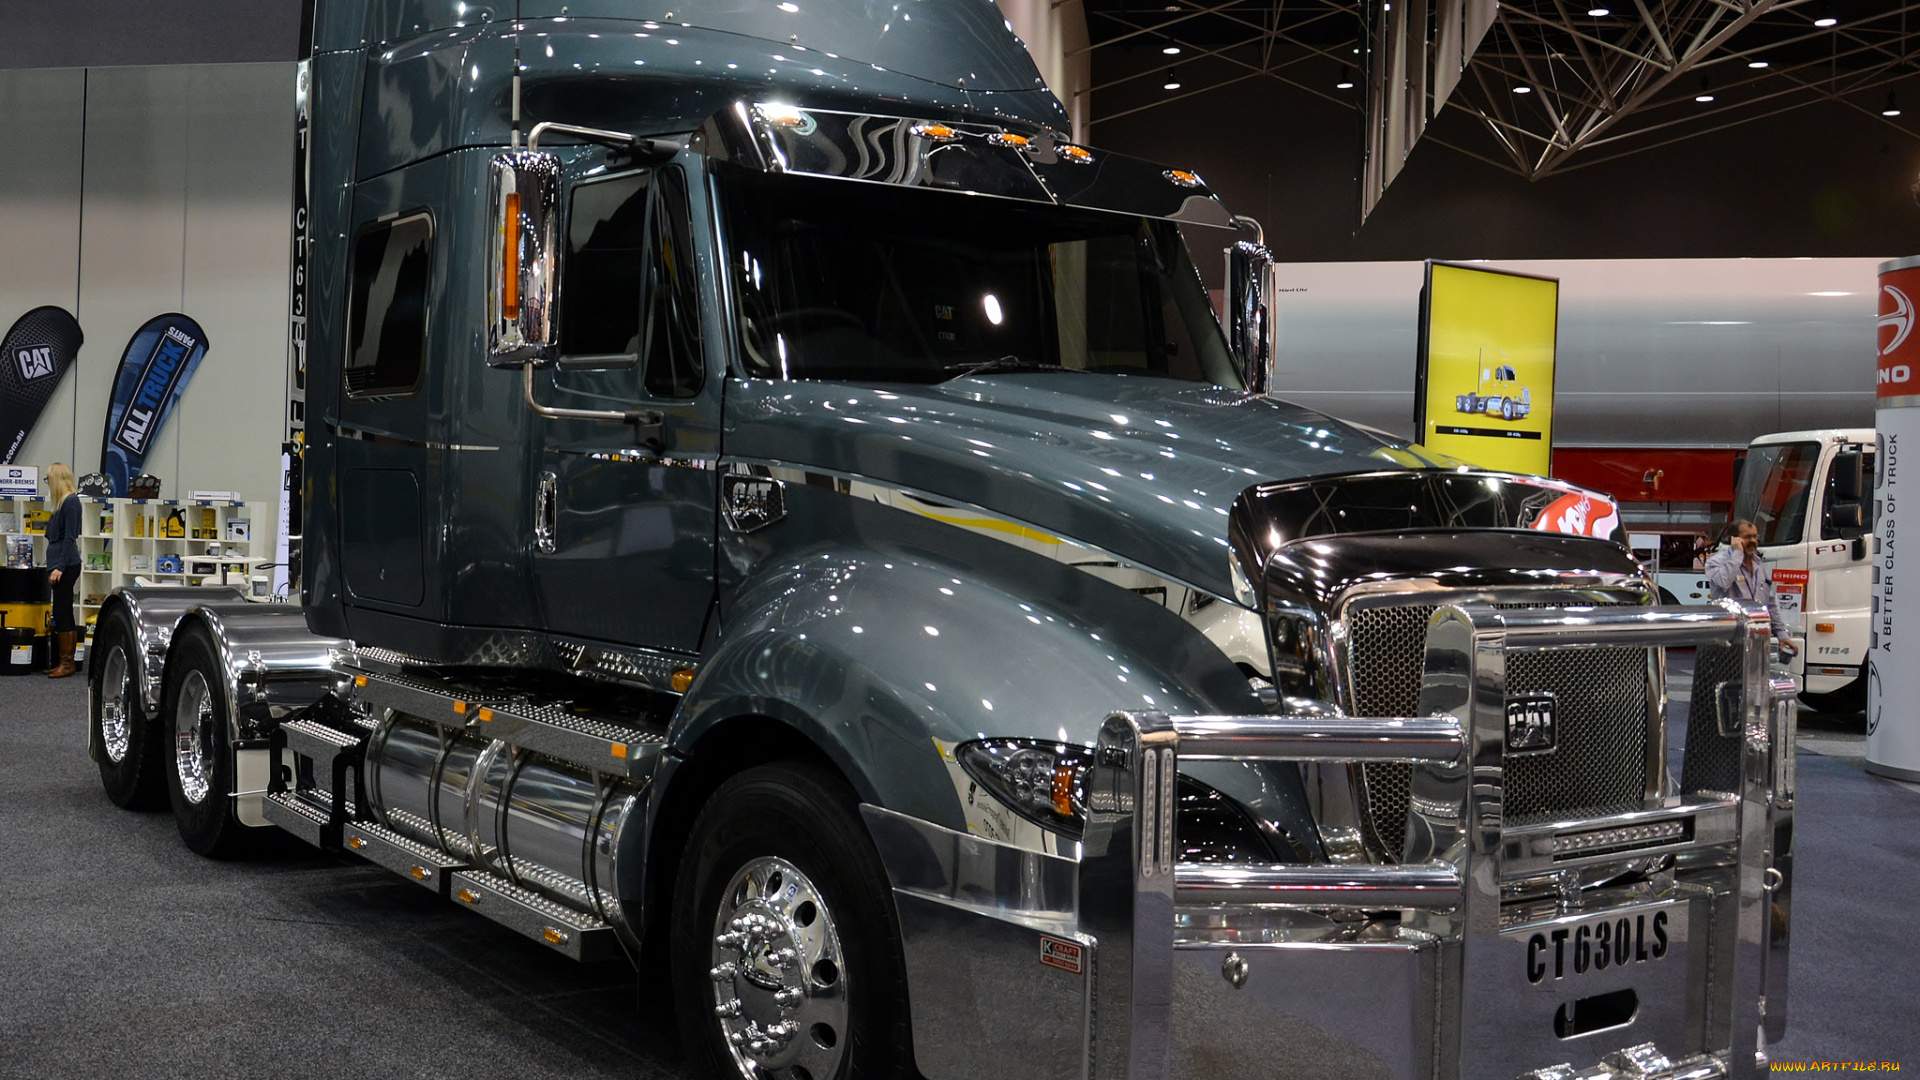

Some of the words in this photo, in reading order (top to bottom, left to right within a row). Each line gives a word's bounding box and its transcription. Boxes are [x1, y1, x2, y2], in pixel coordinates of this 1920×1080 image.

[934, 304, 953, 320] CAT
[167, 326, 196, 347] PARTS
[18, 347, 53, 380] CAT
[121, 408, 153, 450] ALL
[137, 339, 186, 409] TRUCK
[1888, 432, 1898, 488] TRUCK
[733, 481, 772, 519] CAT
[1887, 493, 1897, 514] OF
[1815, 543, 1847, 555] FD
[1885, 519, 1895, 570] CLASS
[1782, 571, 1808, 580] HINO
[1883, 575, 1894, 637] BETTER
[1818, 646, 1850, 655] 1124
[1882, 641, 1892, 652] A
[1508, 701, 1552, 748] CAT
[1054, 943, 1077, 956] CRAFT
[1526, 910, 1669, 985] CT630LS
